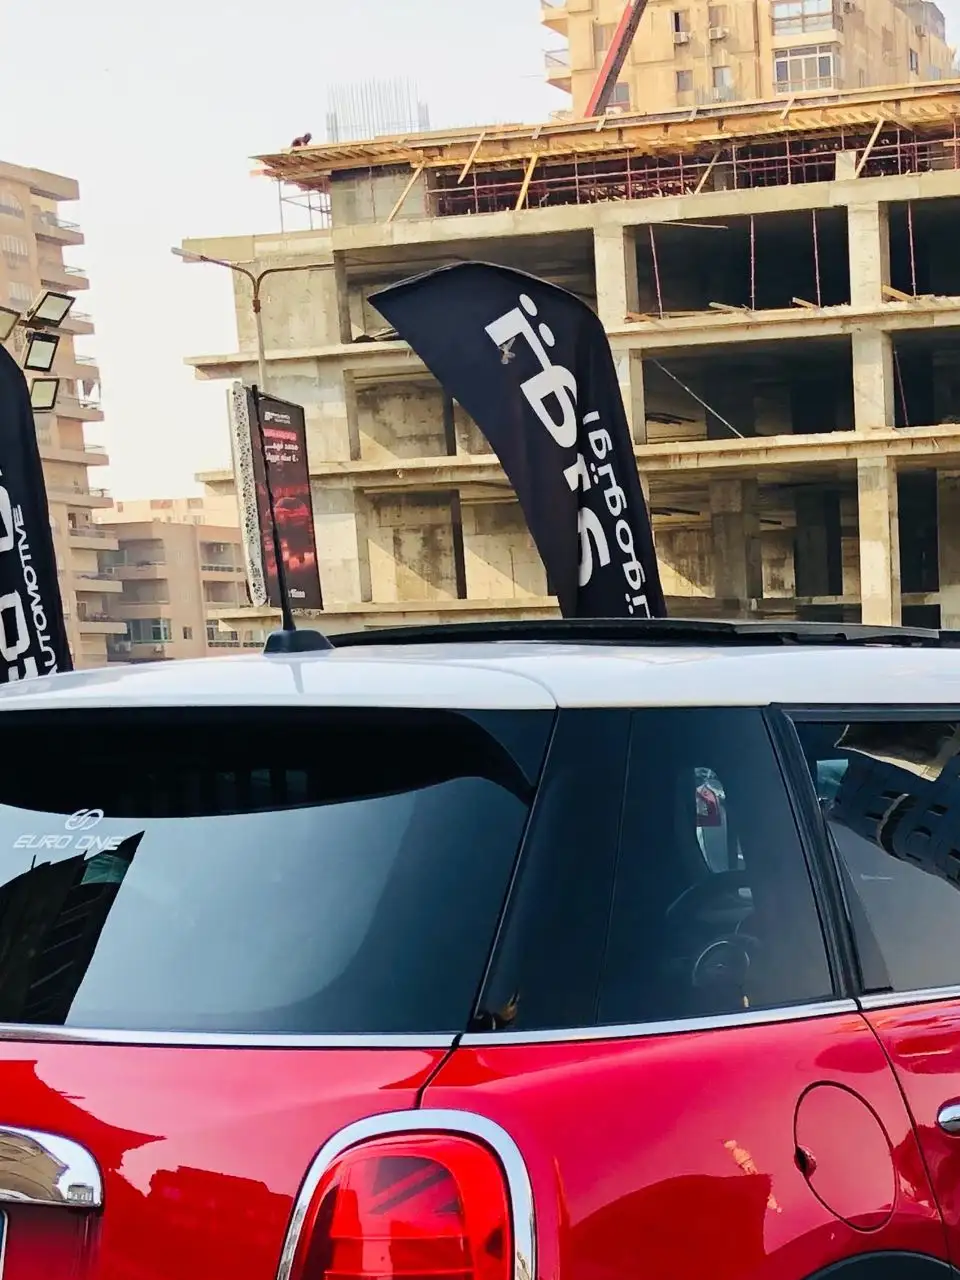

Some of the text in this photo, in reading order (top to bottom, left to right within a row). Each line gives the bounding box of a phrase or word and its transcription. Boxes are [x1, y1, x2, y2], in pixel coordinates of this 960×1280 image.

[582, 410, 655, 619] اوتوموت
[13, 834, 127, 851] EURO ONE
